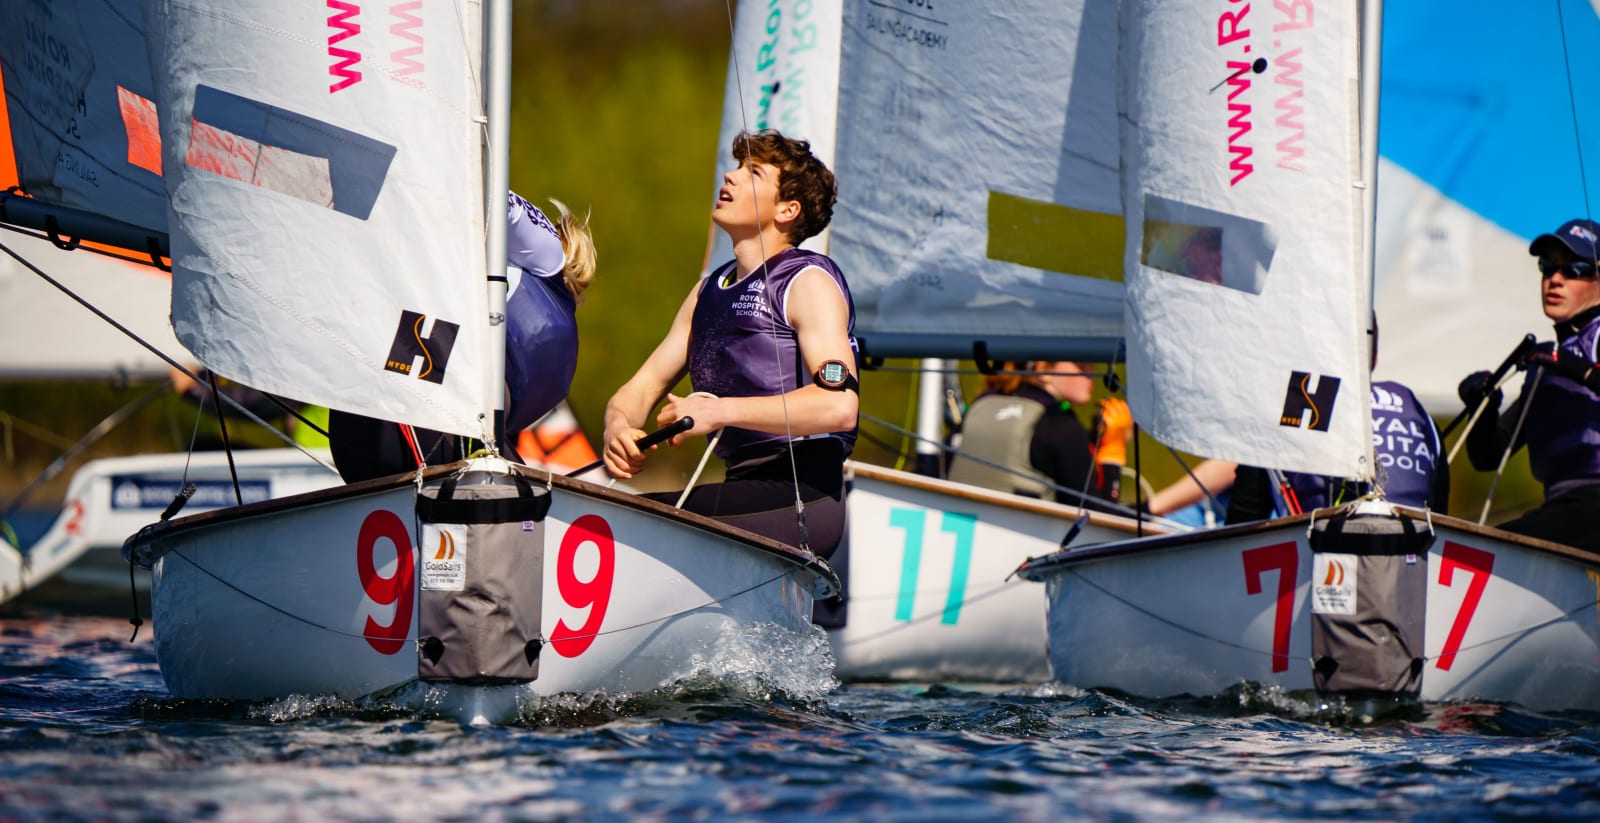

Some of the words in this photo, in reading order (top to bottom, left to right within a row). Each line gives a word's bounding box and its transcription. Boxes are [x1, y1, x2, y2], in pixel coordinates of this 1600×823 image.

[731, 302, 773, 315] HOSPITAL
[735, 309, 765, 319] SCHOOL
[739, 294, 768, 306] ROYAL
[387, 358, 413, 373] HYDE
[356, 508, 416, 656] 9
[548, 513, 616, 659] 9
[888, 506, 979, 627] 11
[1241, 540, 1300, 674] 7
[1434, 539, 1496, 672] 7
